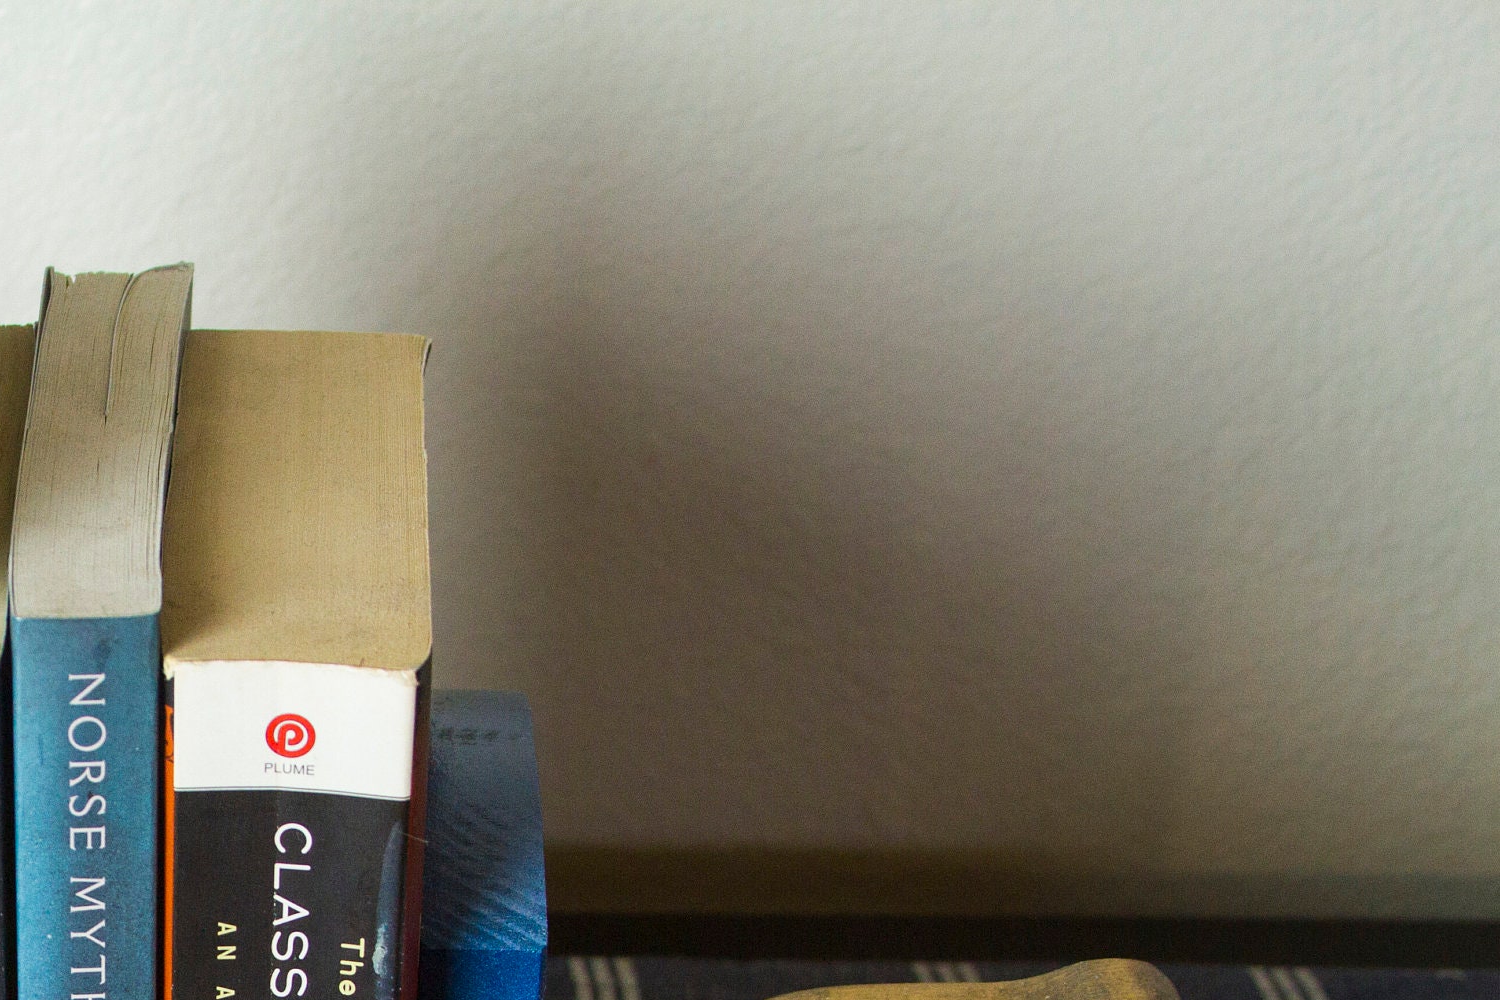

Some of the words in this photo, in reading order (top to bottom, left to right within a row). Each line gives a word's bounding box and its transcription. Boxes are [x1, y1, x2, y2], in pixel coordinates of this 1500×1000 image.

[67, 673, 107, 852] NORSE
[263, 761, 316, 777] PLUME
[216, 921, 238, 961] AN
[338, 937, 366, 996] The
